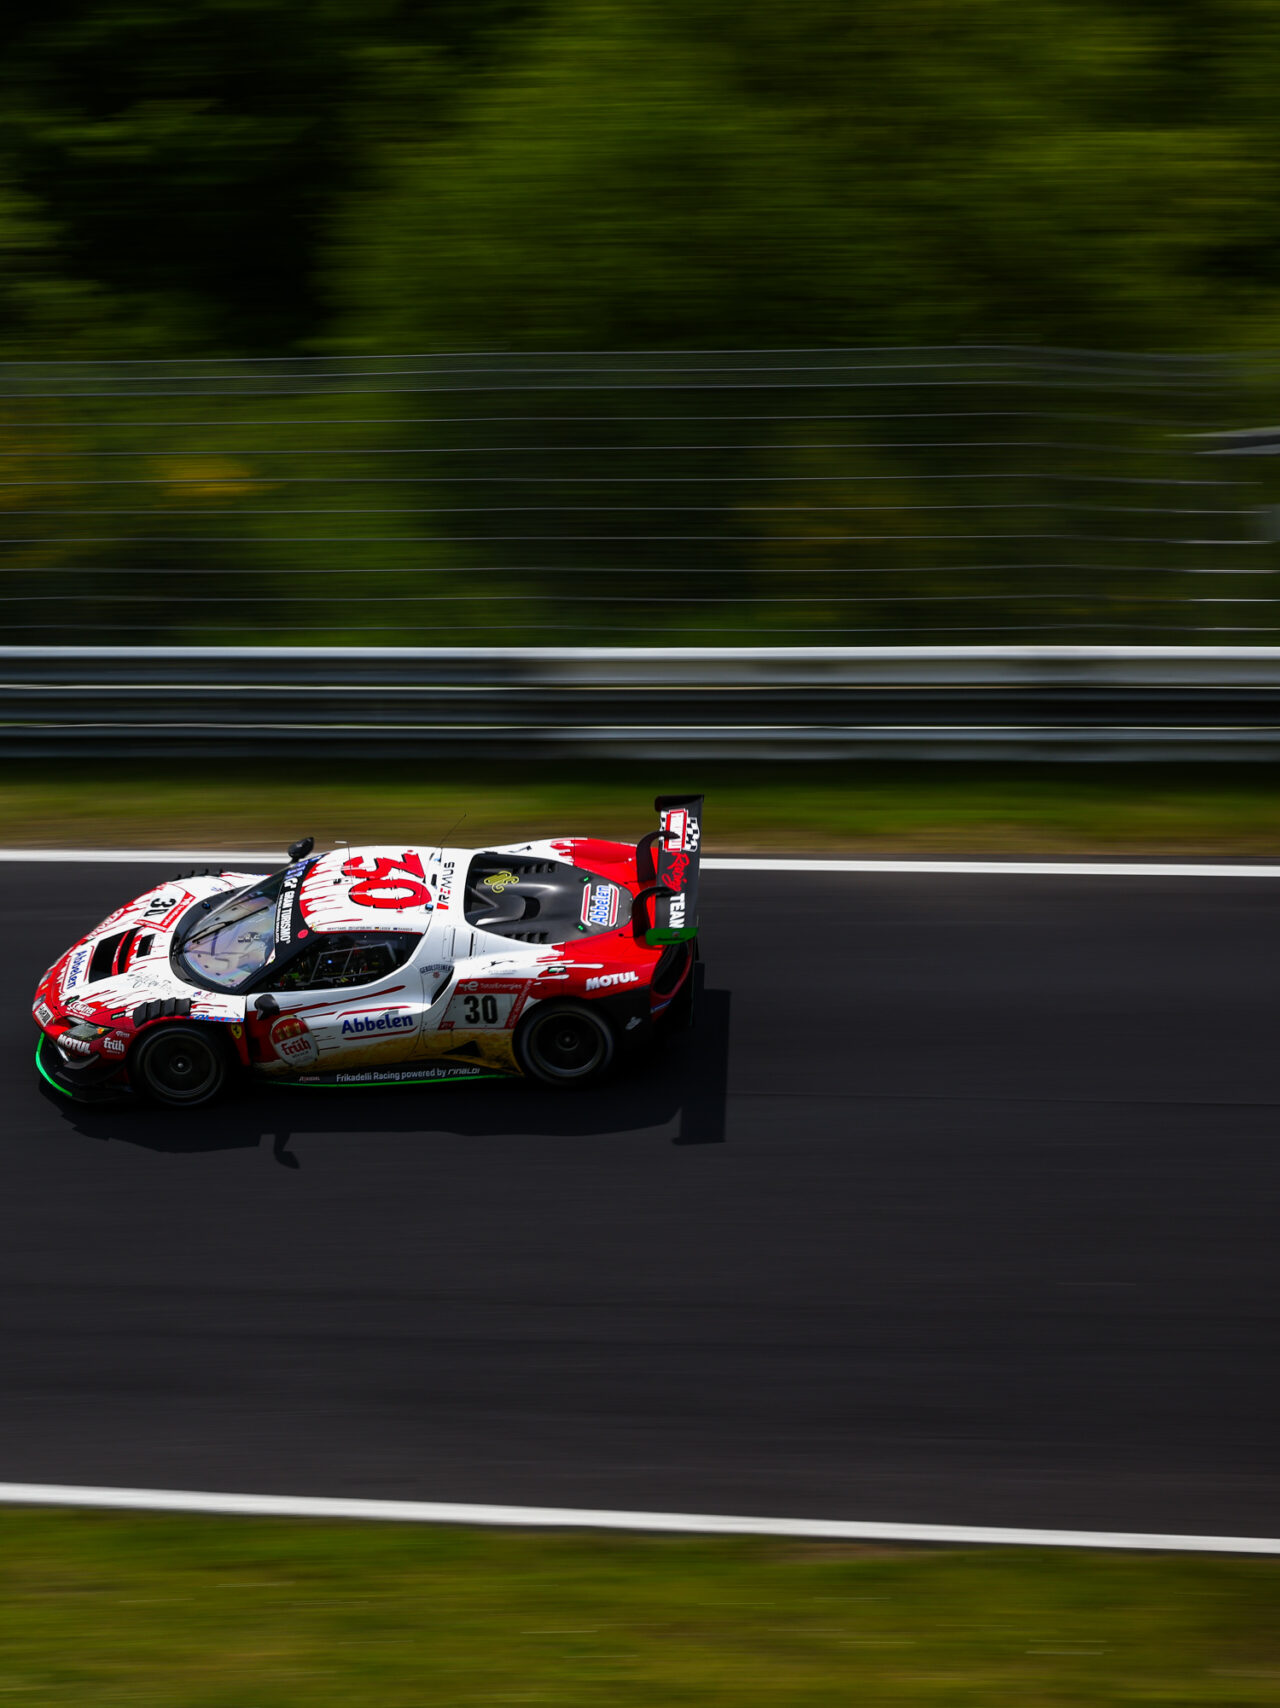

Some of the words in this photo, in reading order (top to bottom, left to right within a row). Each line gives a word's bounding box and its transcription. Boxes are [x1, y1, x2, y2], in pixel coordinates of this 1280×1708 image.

[340, 852, 432, 910] 30
[437, 861, 455, 904] REMUS
[661, 852, 690, 892] Racing
[588, 885, 610, 926] Abbelen
[669, 892, 686, 929] TEAM
[66, 950, 87, 989] Abbelen
[586, 970, 639, 991] MOTUL
[341, 1013, 414, 1034] Abbelen
[463, 995, 498, 1024] 30
[56, 1033, 91, 1054] MOTUL
[103, 1037, 125, 1053] früh
[281, 1037, 312, 1056] früh
[336, 1071, 372, 1082] Frikadelli
[373, 1069, 400, 1080] Racing
[401, 1066, 436, 1080] powered
[436, 1066, 447, 1077] by
